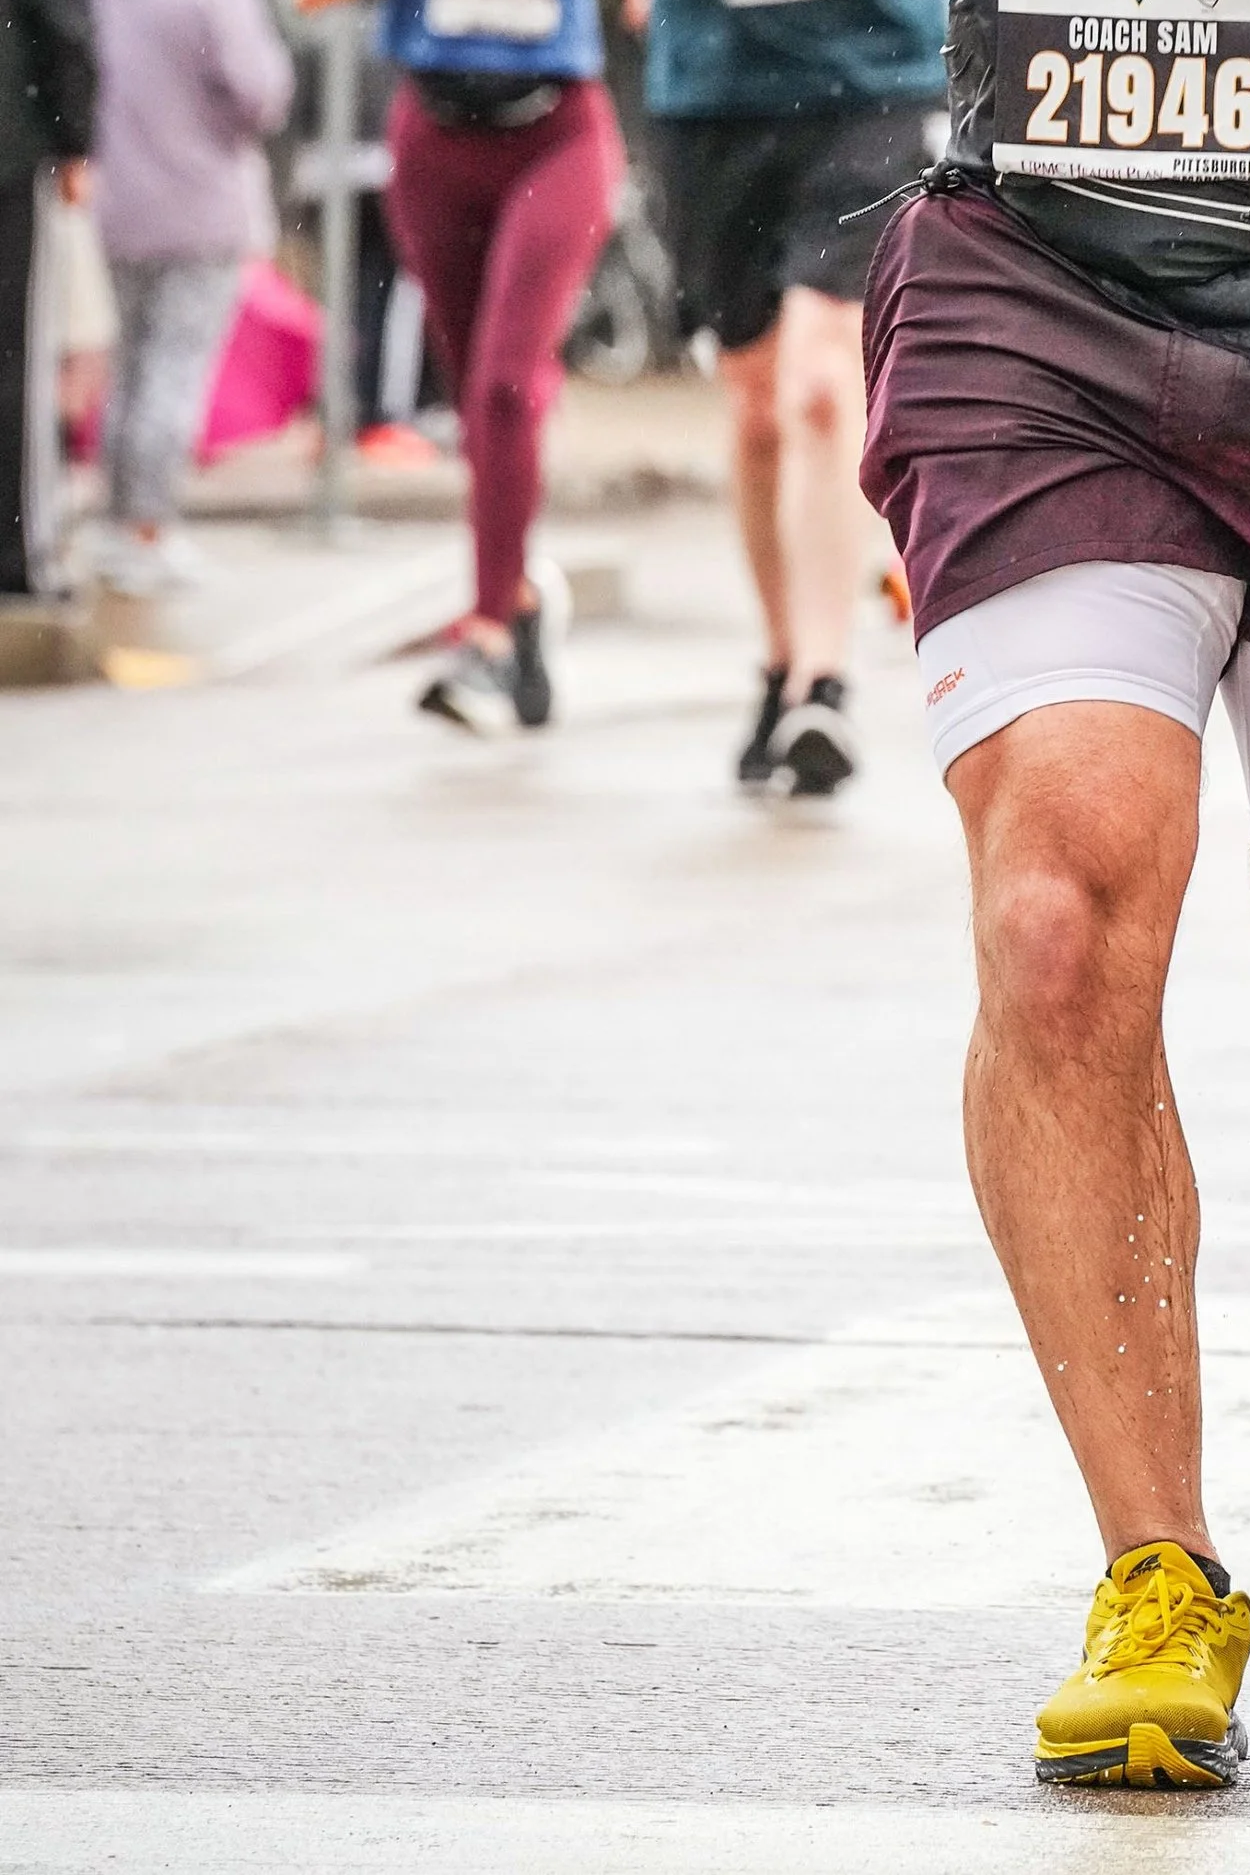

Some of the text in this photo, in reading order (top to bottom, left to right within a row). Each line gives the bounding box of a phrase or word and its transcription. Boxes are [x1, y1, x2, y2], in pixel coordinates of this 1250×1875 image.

[1069, 16, 1217, 55] COACH SAM
[1021, 160, 1065, 175] UPMC
